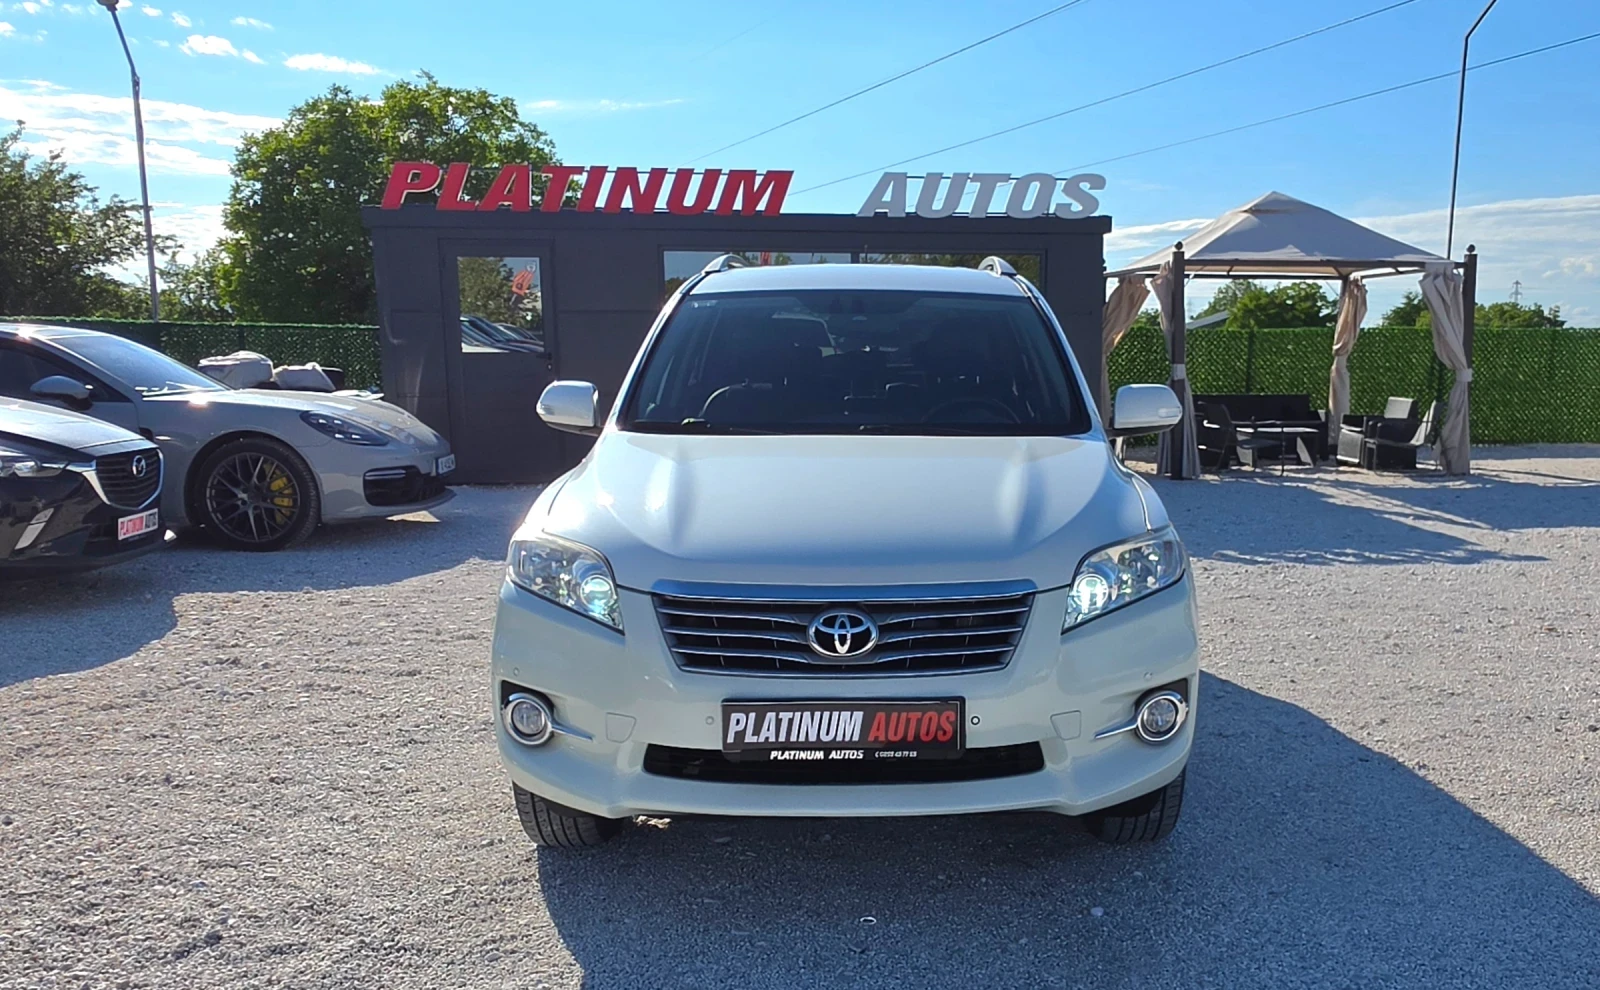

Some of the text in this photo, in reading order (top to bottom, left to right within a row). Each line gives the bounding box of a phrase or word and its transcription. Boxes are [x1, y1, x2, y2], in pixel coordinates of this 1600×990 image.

[381, 161, 1107, 219] PLATINUM AUTOS
[726, 711, 956, 743] PLATINUM AUTOS
[769, 750, 825, 760] PLATINUM
[828, 750, 864, 760] AUTOS
